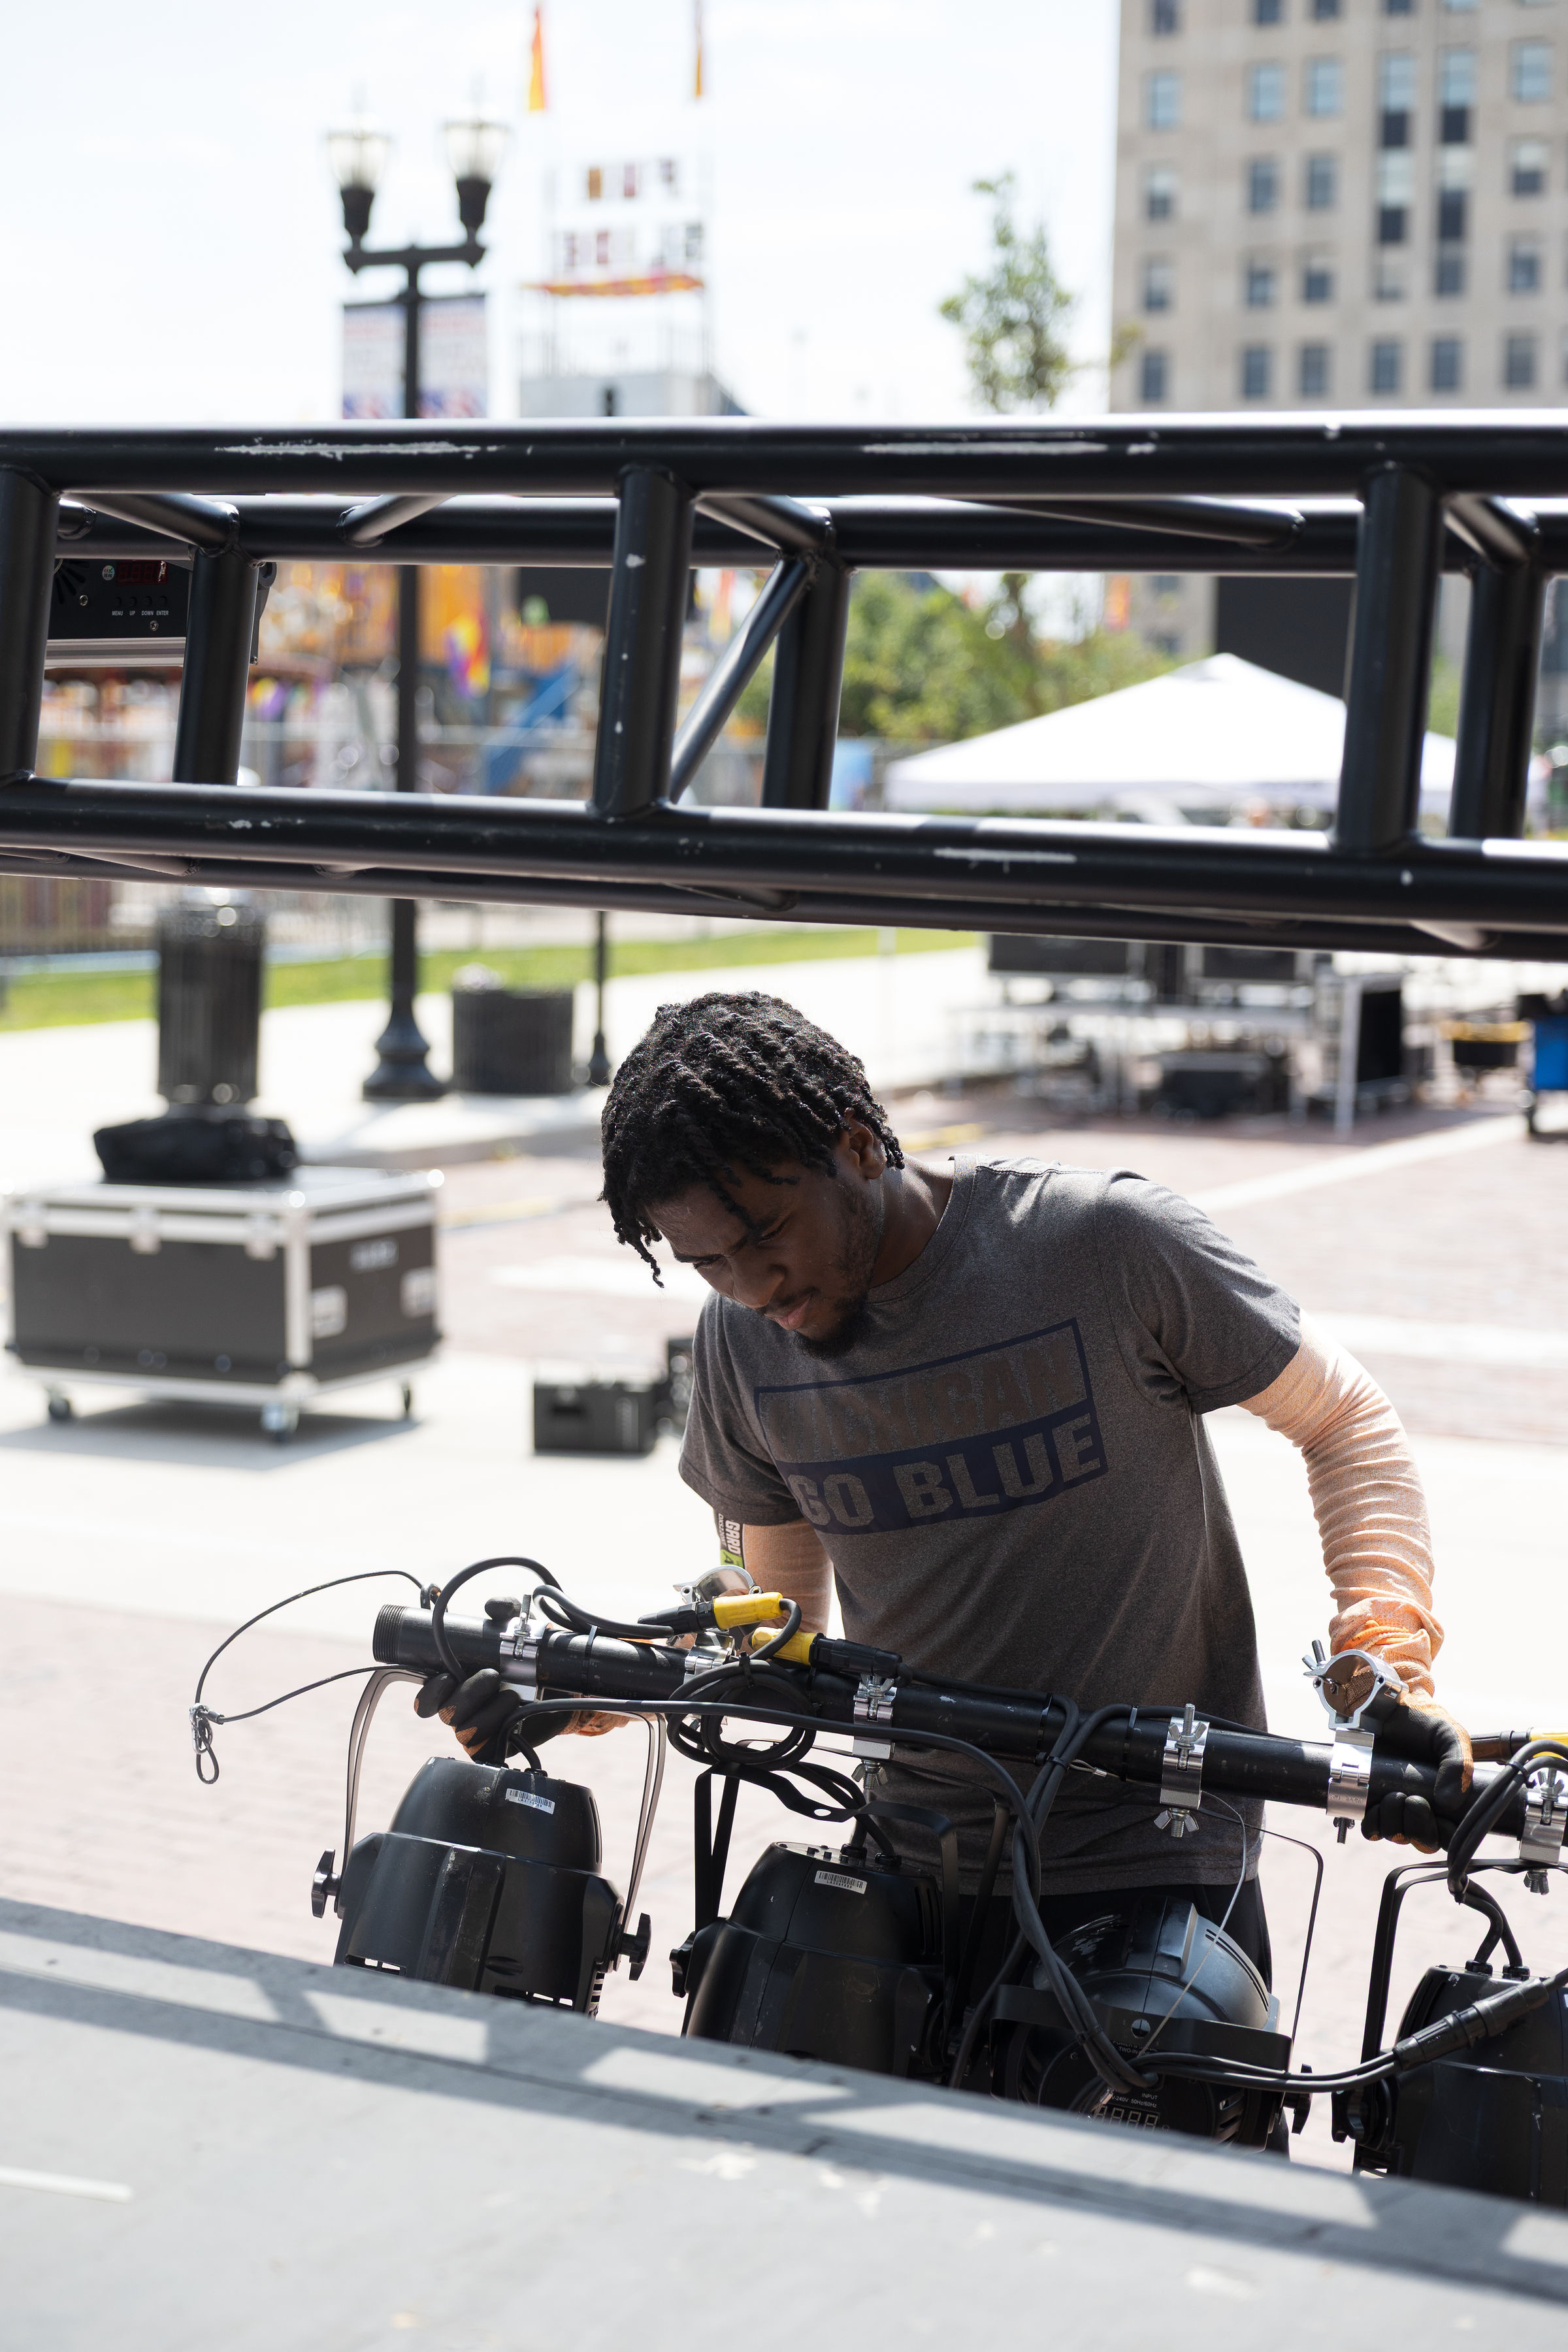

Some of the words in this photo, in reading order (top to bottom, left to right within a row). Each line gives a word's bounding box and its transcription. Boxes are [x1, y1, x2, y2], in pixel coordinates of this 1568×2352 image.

[768, 1340, 1078, 1461] MICHIGAN
[788, 1473, 875, 1527] GO
[892, 1413, 1102, 1518] BLUE
[725, 1520, 742, 1556] GARD
[1131, 2099, 1157, 2108] 50Hz/60Hz
